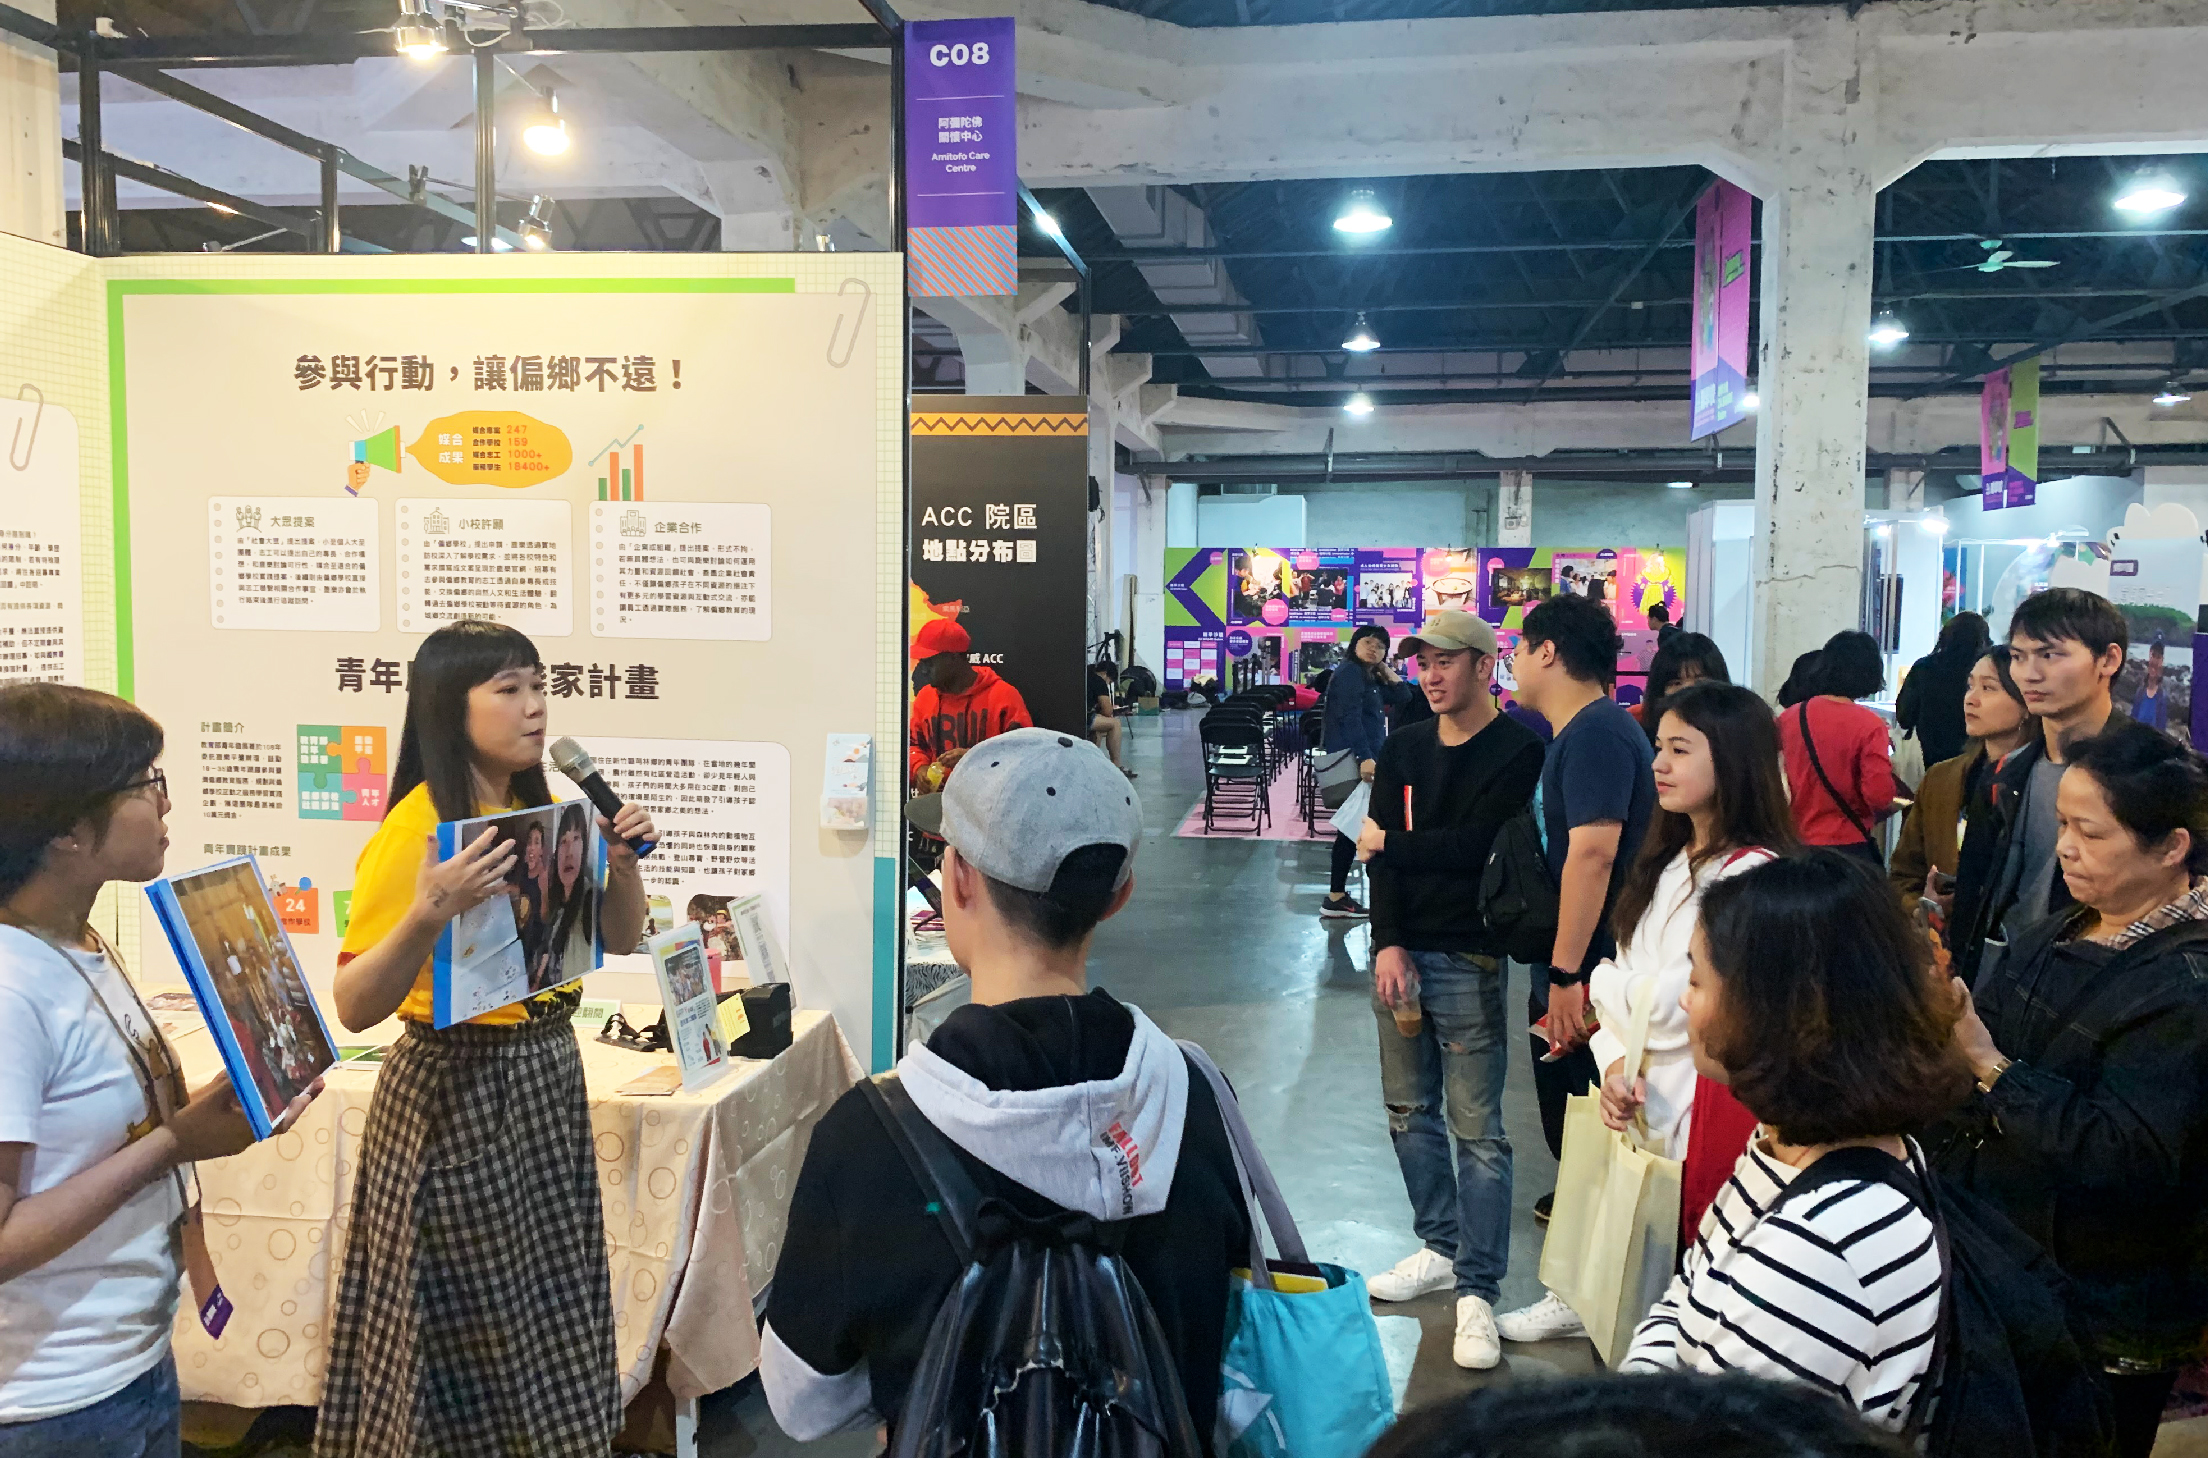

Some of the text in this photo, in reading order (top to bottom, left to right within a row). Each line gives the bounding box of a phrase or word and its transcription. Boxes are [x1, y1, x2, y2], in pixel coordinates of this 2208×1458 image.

[930, 42, 990, 67] C08
[938, 116, 983, 129] 阿彌陀佛
[938, 130, 983, 143] 關懷中心
[931, 151, 990, 162] Amitofo Care
[945, 163, 976, 173] Centre
[293, 354, 683, 393] 參與行動，讓偏鄉不遠！
[506, 425, 527, 434] 247
[438, 433, 463, 446] 媒合
[438, 451, 464, 464] 成果
[508, 449, 542, 459] 1000+
[508, 462, 550, 472] 18400+
[921, 503, 1038, 530] ACC 院區
[654, 521, 702, 534] 企業合作
[922, 539, 1038, 563] 地點分布圖
[982, 653, 1004, 664] ACC
[335, 657, 660, 700] 青年 家計畫
[362, 797, 380, 806] 人才
[286, 898, 306, 913] 24
